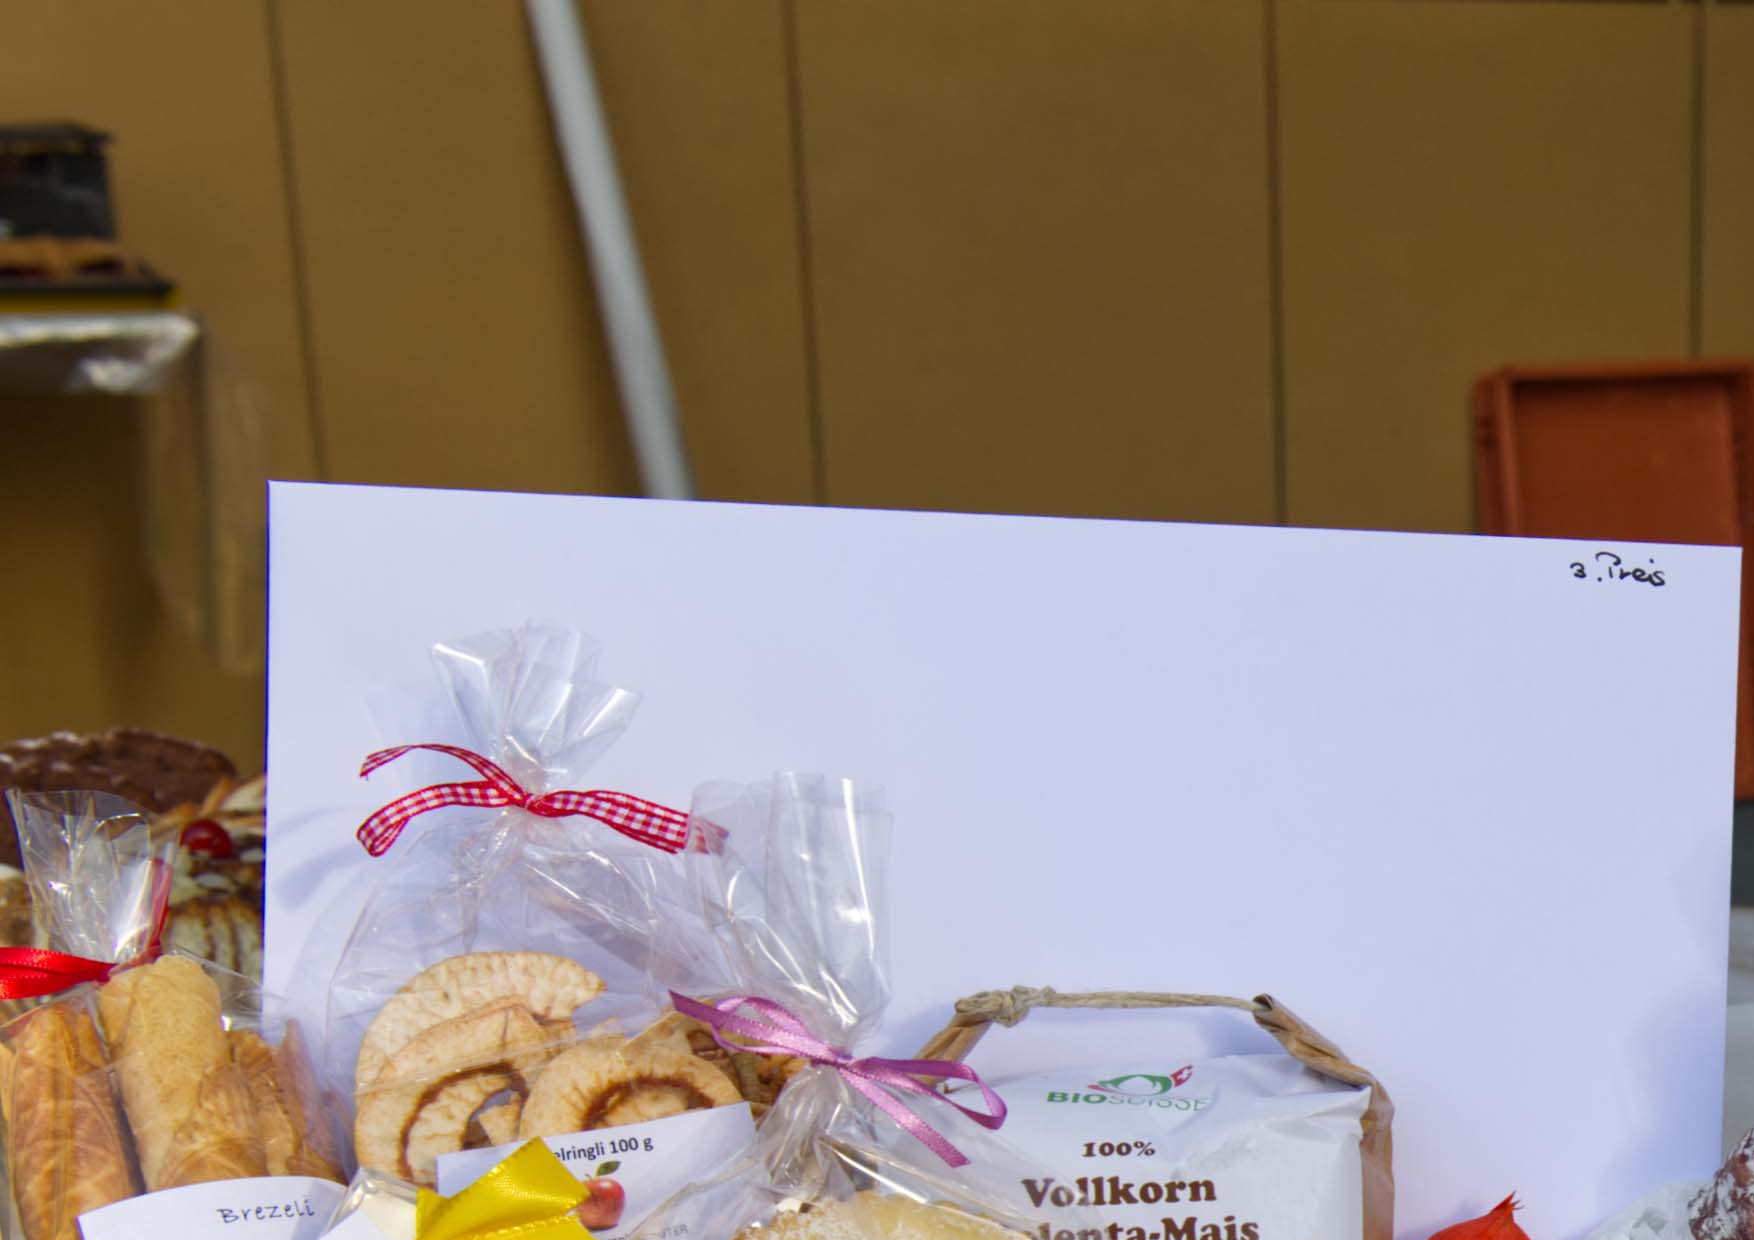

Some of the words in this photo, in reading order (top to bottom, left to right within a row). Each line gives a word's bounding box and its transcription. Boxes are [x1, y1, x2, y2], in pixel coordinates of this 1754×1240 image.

[609, 1137, 639, 1154] 100
[643, 1136, 655, 1151] g
[1081, 1141, 1156, 1157] 100%
[1021, 1176, 1218, 1209] Vollkorn
[216, 1199, 316, 1224] Brezeli
